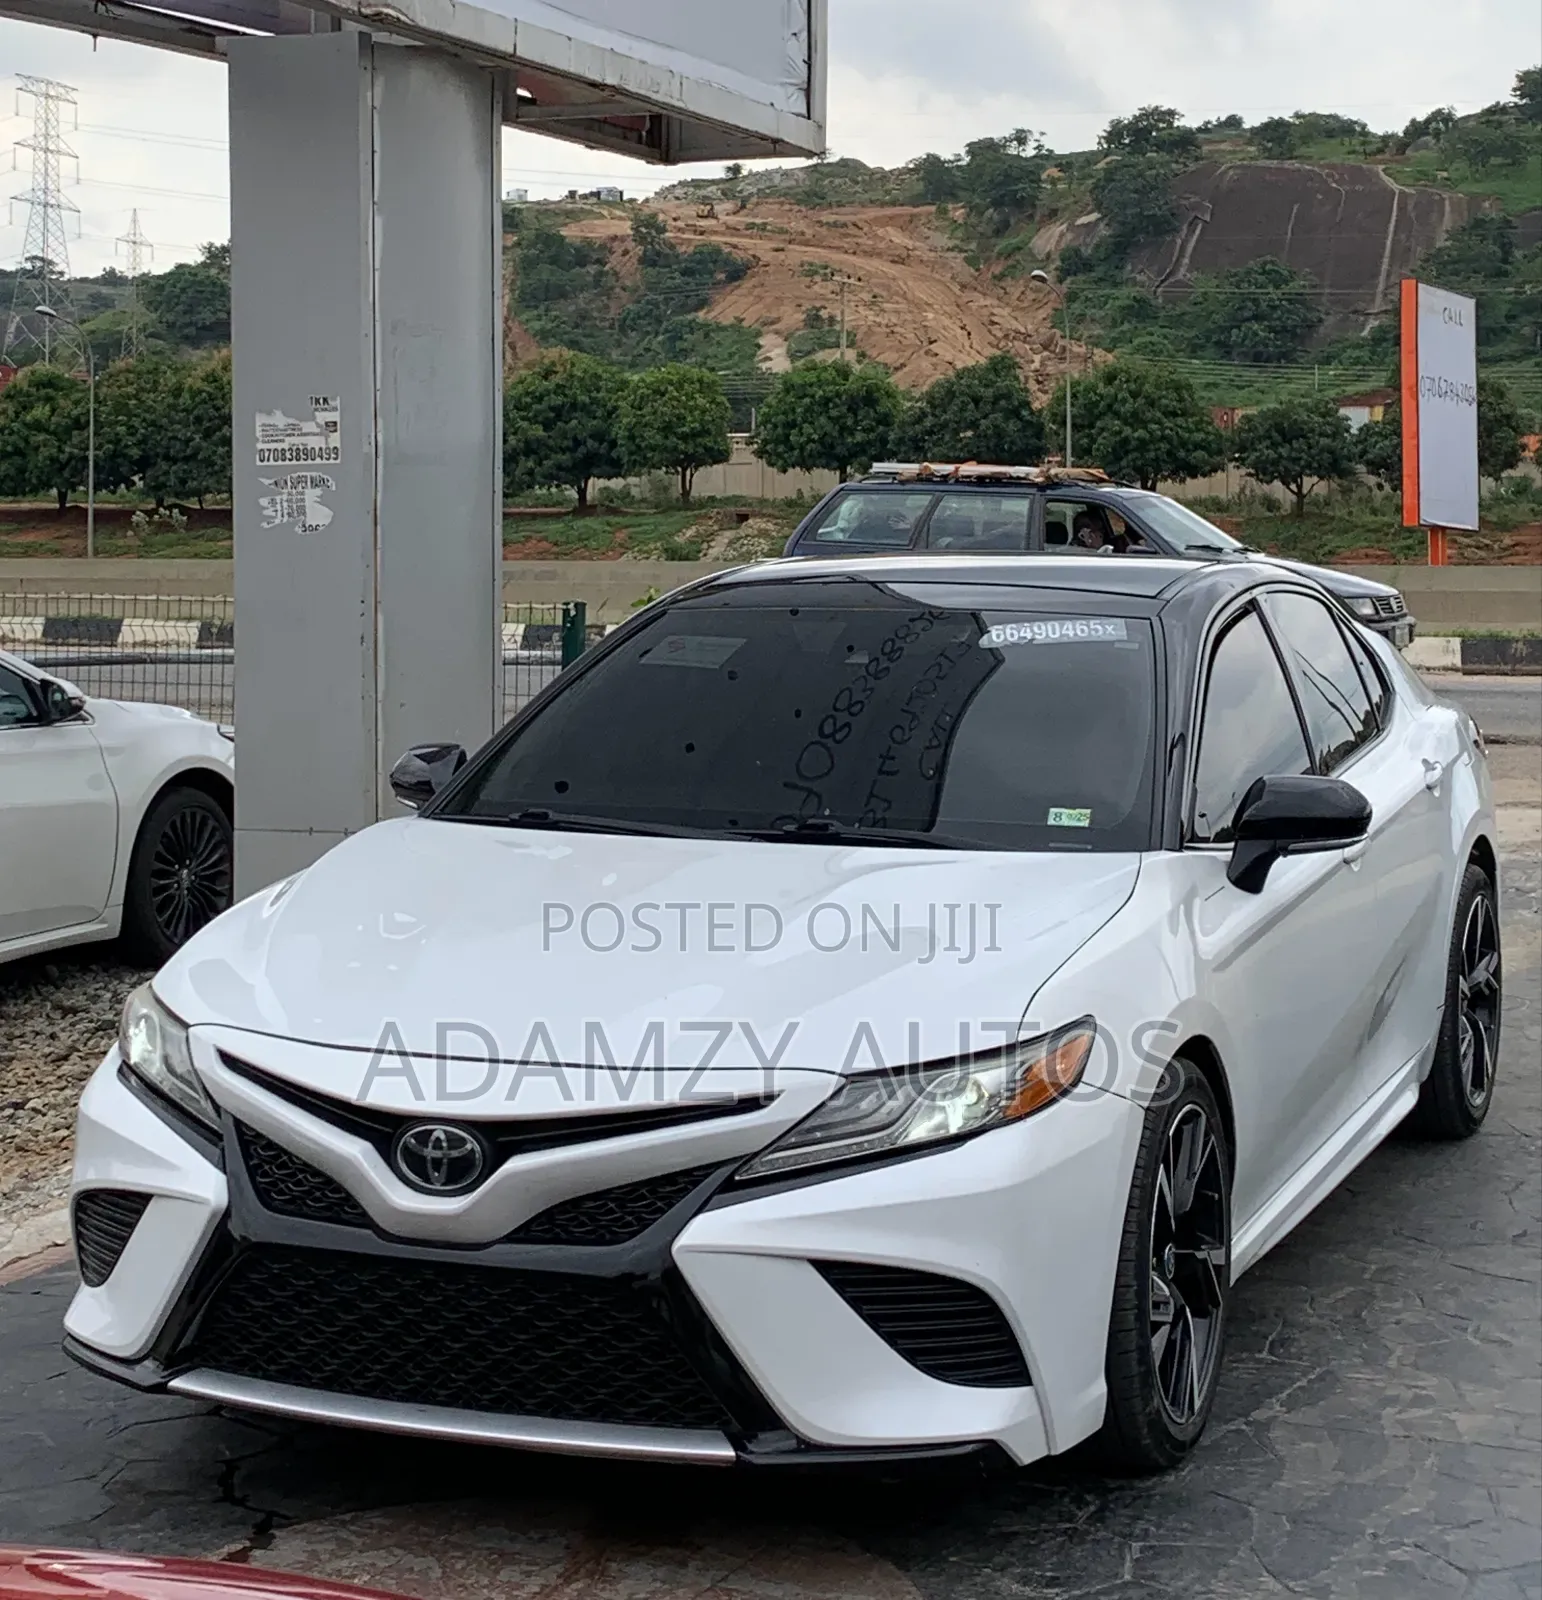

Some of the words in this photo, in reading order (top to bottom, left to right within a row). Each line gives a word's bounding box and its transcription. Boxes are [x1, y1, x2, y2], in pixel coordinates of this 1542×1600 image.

[1442, 307, 1463, 327] CALL
[259, 446, 339, 463] 07083890499
[991, 619, 1116, 643] 66490465x
[1053, 811, 1063, 824] 8
